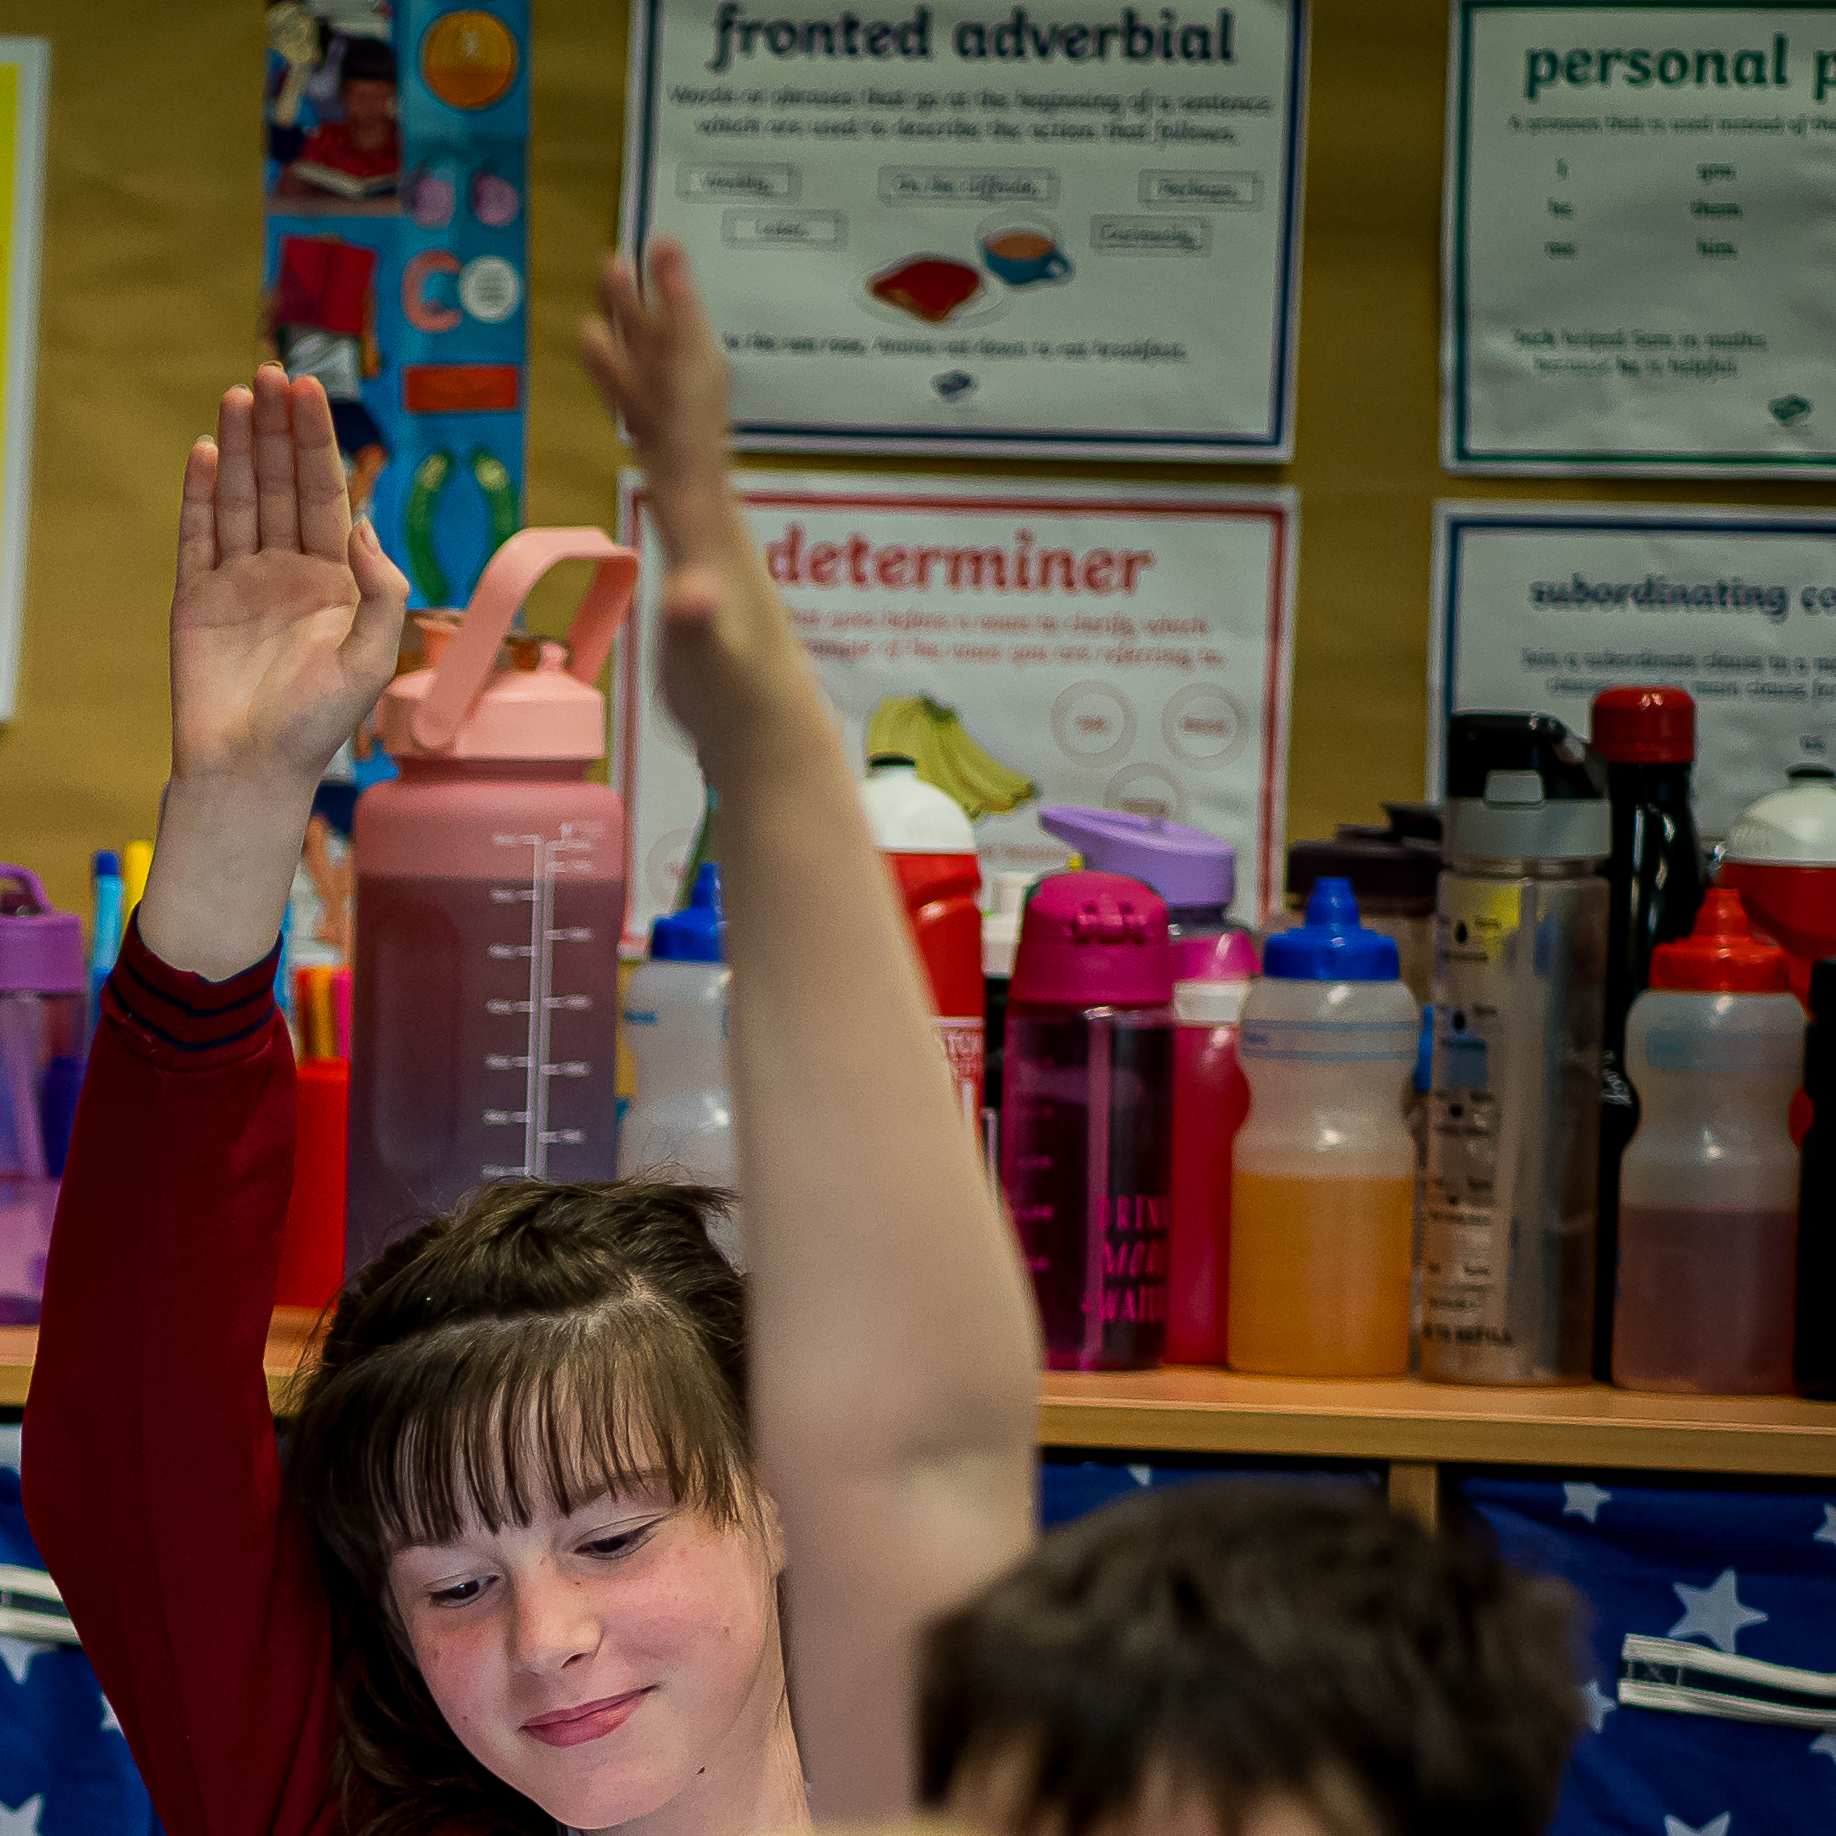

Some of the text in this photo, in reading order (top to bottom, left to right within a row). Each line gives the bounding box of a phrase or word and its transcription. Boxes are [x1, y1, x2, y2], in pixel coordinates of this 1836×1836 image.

[707, 8, 1237, 74] fronted adverbial
[1524, 33, 1789, 100] personal
[766, 522, 1153, 594] determiner
[1529, 572, 1791, 624] subordinating
